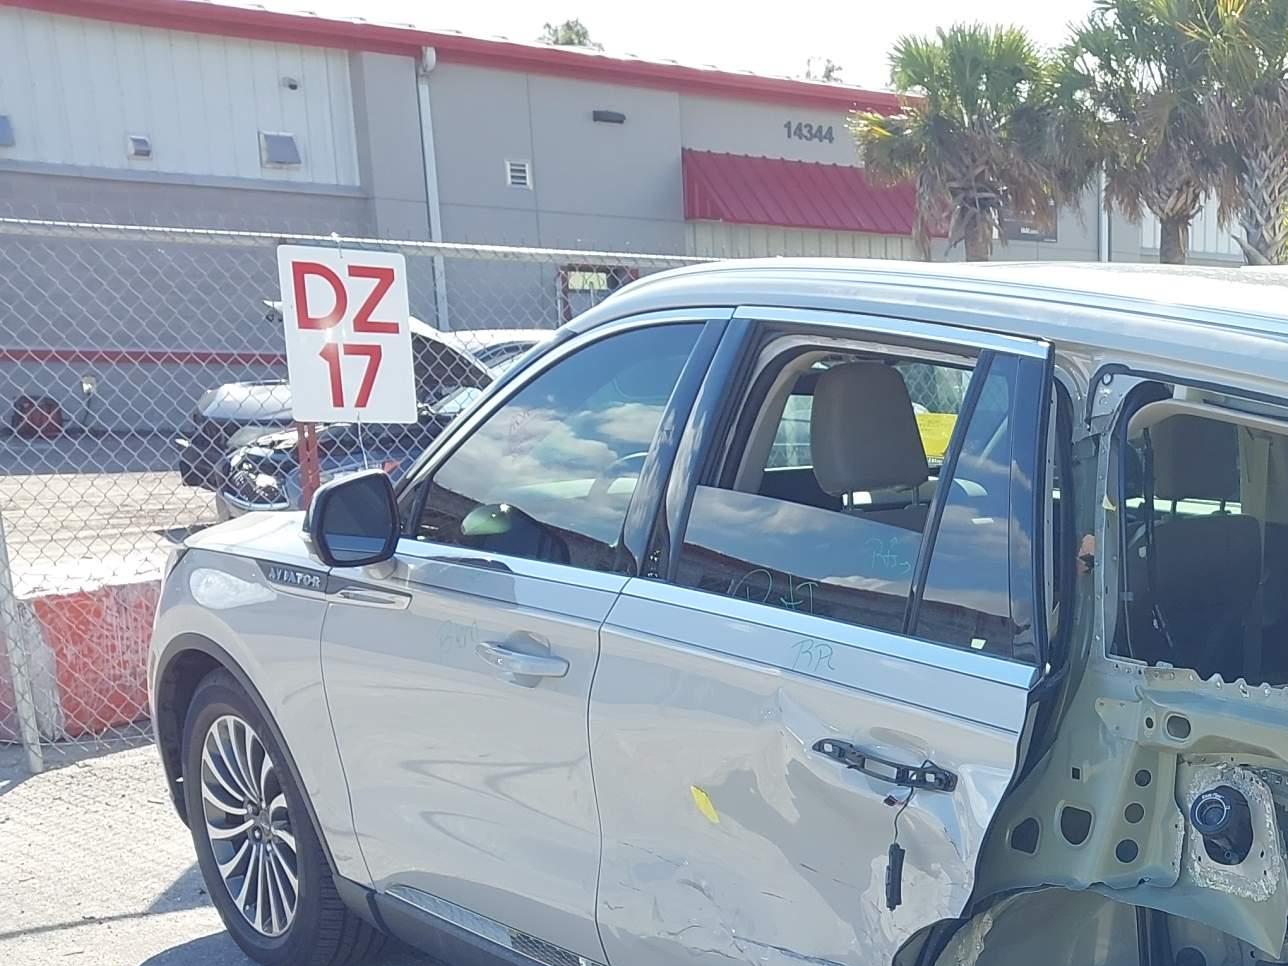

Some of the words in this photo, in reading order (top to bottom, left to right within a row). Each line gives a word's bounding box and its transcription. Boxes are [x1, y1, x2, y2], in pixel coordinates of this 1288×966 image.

[783, 120, 835, 144] 14344
[291, 261, 400, 334] DZ
[319, 342, 382, 408] 17
[268, 567, 321, 588] AVIATOR
